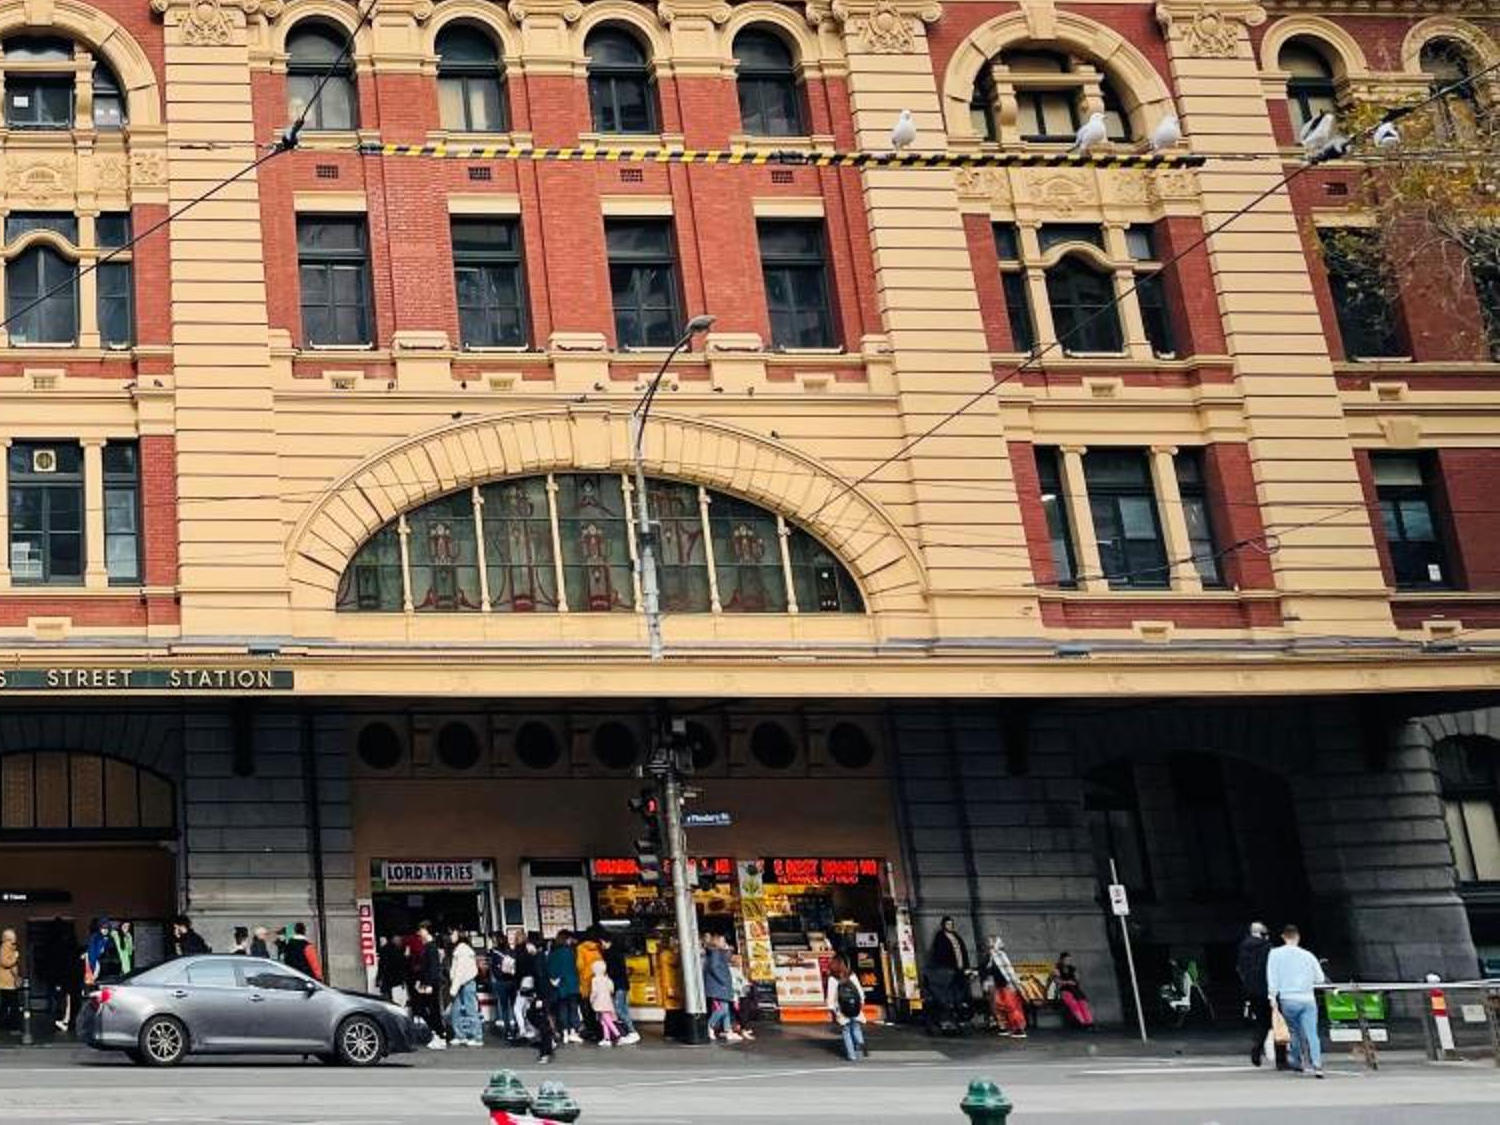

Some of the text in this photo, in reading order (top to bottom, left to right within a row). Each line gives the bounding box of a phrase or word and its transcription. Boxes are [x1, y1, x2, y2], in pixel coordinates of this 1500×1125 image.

[47, 669, 133, 688] STREET
[169, 669, 273, 688] STATION
[387, 866, 422, 880] LORD
[437, 865, 473, 880] FRIES
